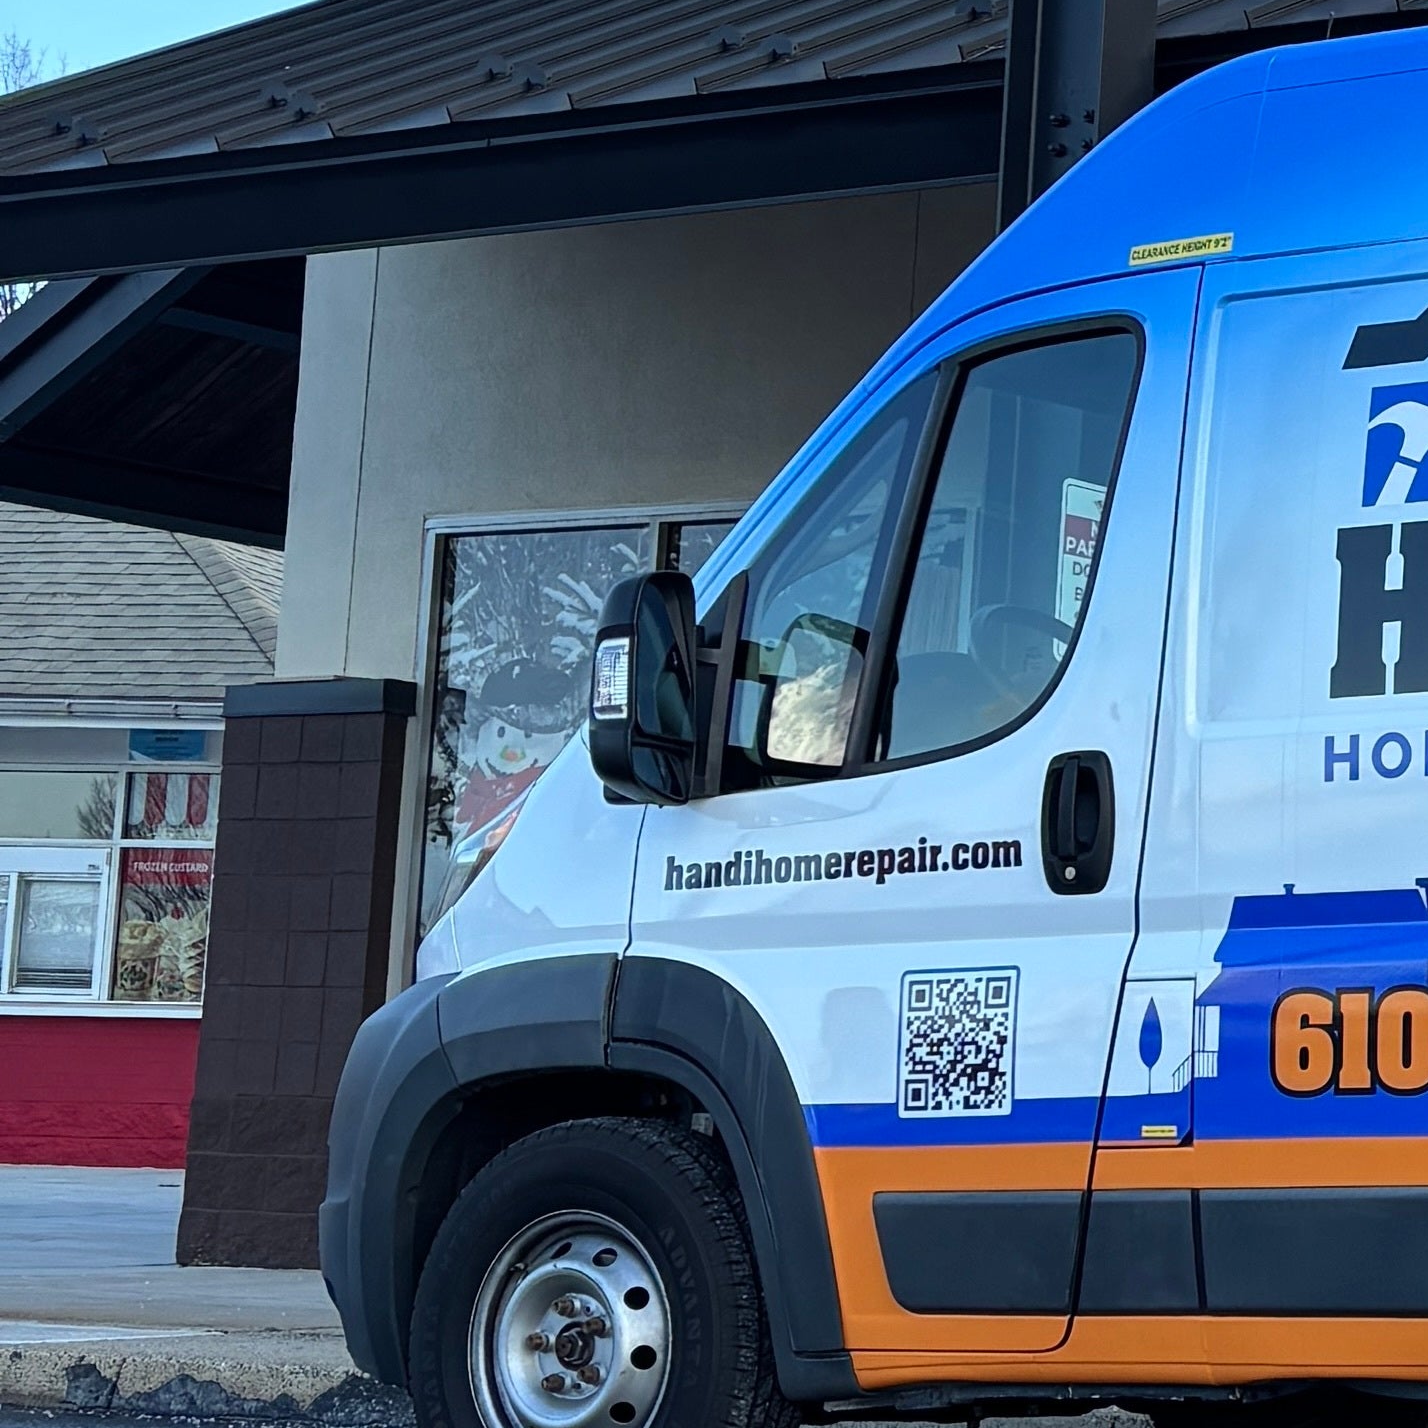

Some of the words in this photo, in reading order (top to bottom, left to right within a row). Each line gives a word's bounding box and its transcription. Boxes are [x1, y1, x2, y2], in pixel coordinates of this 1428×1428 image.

[1131, 244, 1180, 261] CLEARANCE
[1181, 239, 1213, 253] HEIGHT
[134, 862, 168, 873] FROZEN
[168, 862, 209, 873] CUSTARD
[664, 836, 1023, 891] handihomerepair.com
